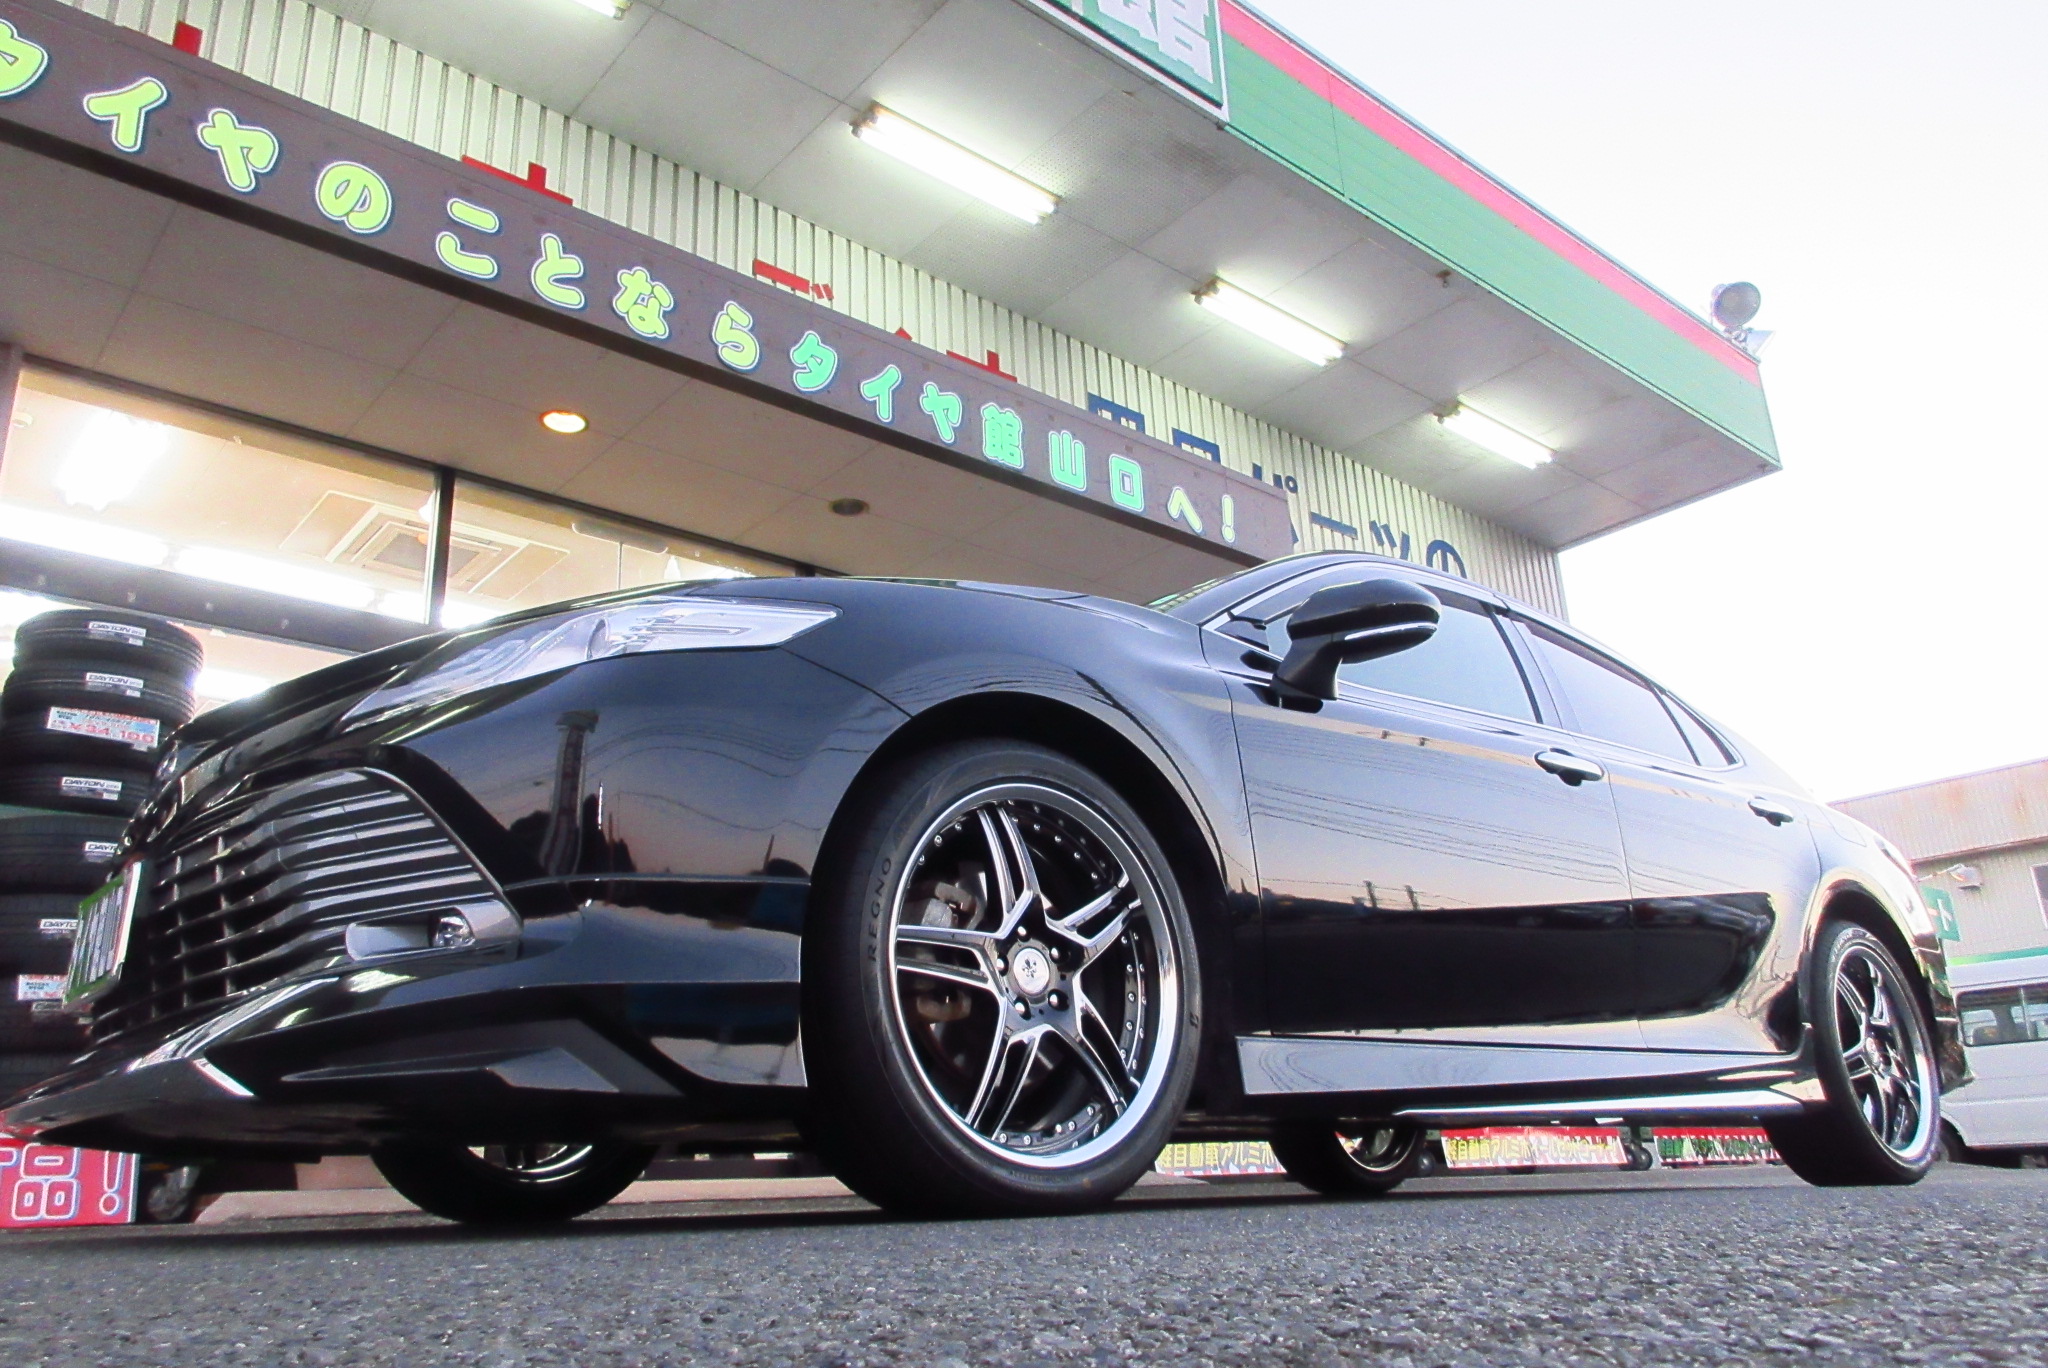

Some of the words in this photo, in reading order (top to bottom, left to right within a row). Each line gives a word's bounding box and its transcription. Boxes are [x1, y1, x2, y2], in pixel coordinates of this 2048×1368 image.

[89, 674, 129, 684] DAYTON
[64, 779, 106, 788] DAYTON
[868, 858, 892, 962] REGNO
